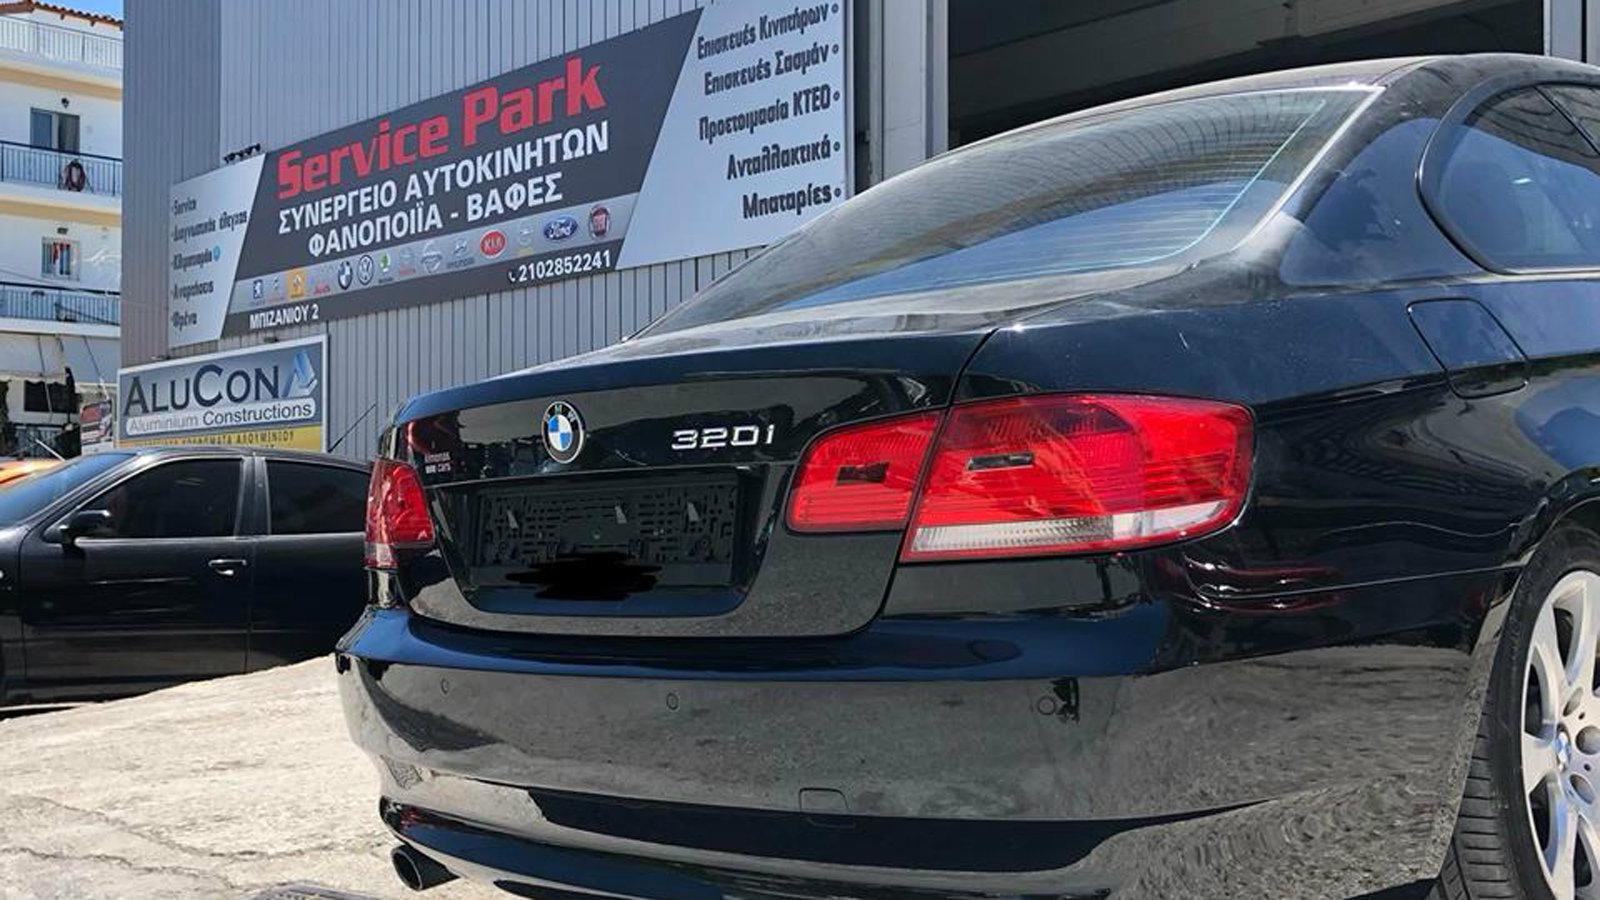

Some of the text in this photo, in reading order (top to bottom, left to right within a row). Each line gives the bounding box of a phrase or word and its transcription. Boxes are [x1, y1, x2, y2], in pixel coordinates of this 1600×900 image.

[698, 24, 756, 60] Επισκευές
[705, 42, 829, 96] Επισκευές Σασμάν
[277, 55, 607, 199] Service Park
[699, 84, 831, 145] Προετοιμασία ΚΤΕΟ
[278, 120, 609, 235] ΣΥΝΕΡΓΕΙΟ ΑΥΤΟΚΙΝΗΤΩΝ
[727, 134, 831, 180] Ανταλλακτικά
[467, 173, 563, 222] ΒΑΦΕΣ
[743, 183, 832, 219] Μπαταρίες
[519, 250, 611, 282] 2102852241
[250, 303, 319, 329] ΜΠΙΖΑΝΙΟΥ 2
[130, 403, 312, 432] Aluminium Constructions
[671, 424, 775, 450] 320i
